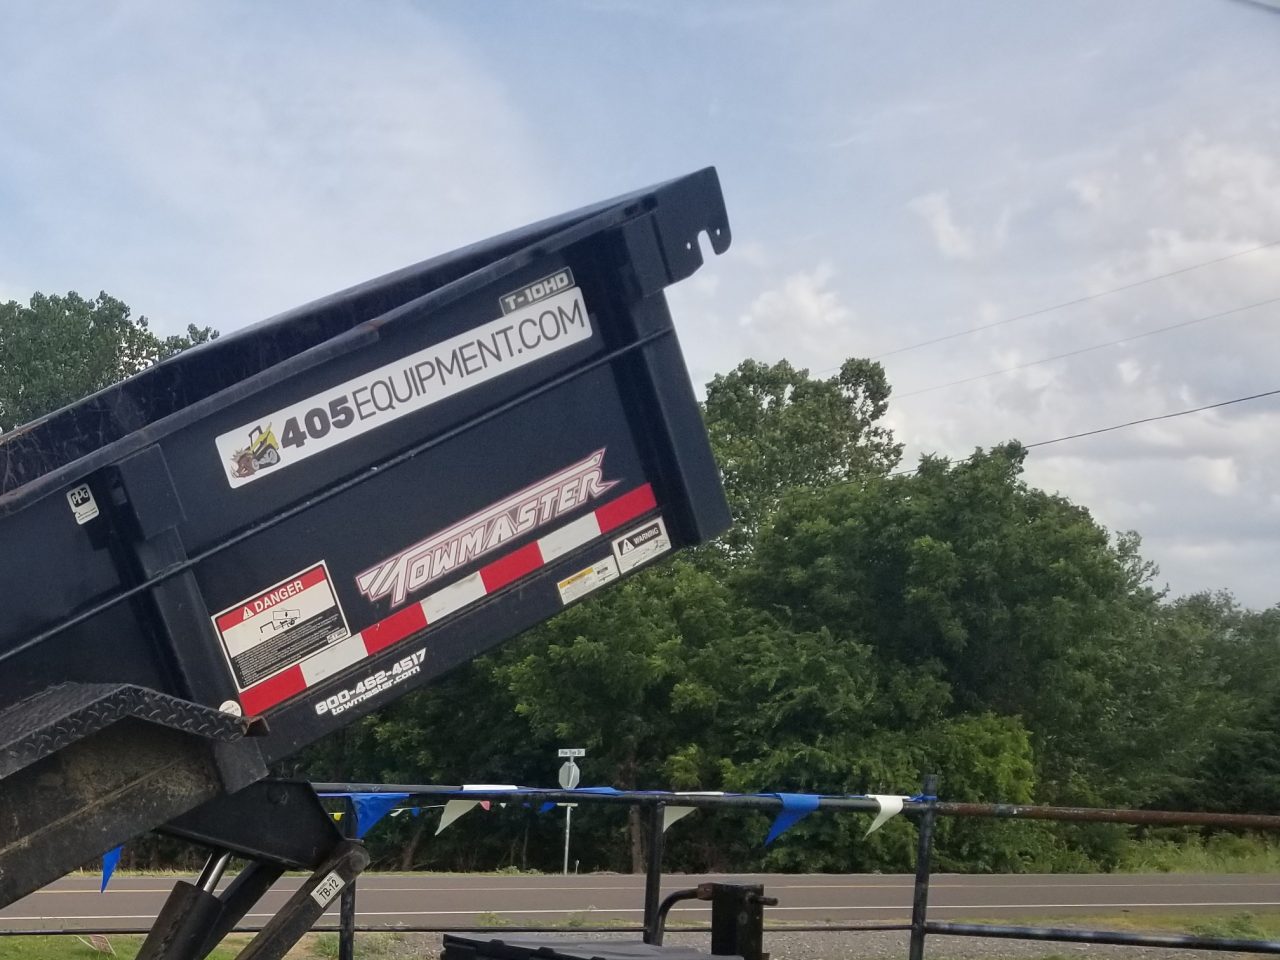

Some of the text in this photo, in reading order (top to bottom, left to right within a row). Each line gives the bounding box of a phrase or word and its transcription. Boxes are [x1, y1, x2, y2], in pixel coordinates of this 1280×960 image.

[505, 272, 569, 310] T-10HD
[281, 298, 585, 450] 405EQUIPMENT.COM
[355, 448, 619, 608] TOWMASTER
[633, 527, 660, 545] WARNING
[254, 580, 304, 613] DANGER
[314, 647, 427, 716] 800-462-4517
[331, 665, 421, 716] towmaster.com
[318, 879, 340, 901] TB-12
